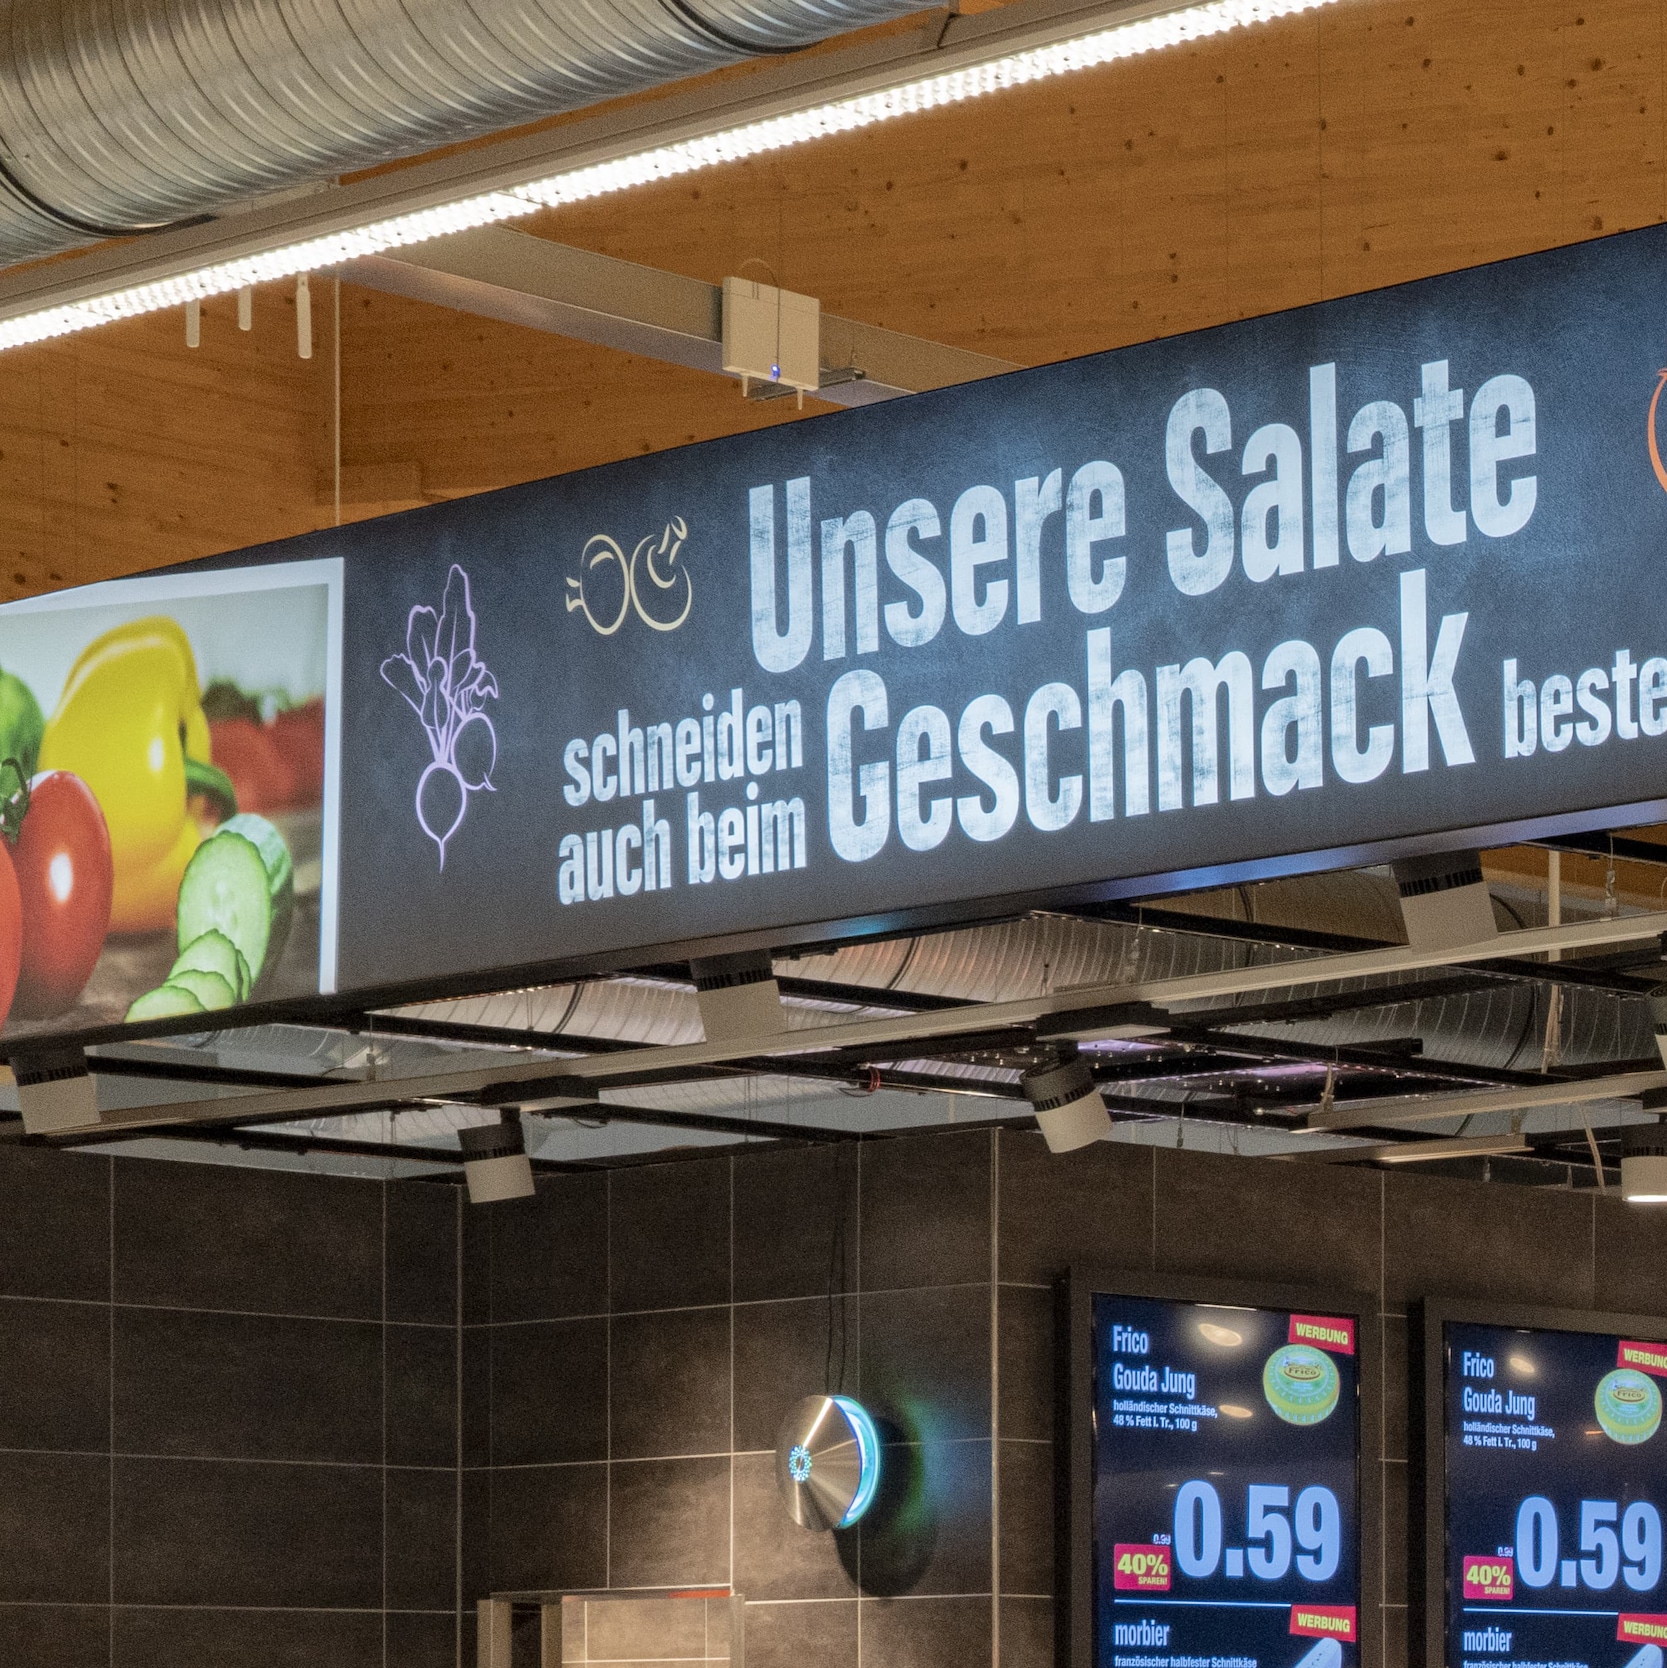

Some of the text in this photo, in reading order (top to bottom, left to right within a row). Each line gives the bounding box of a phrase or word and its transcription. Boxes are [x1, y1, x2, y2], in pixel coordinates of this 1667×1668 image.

[748, 359, 1538, 675] Unsere Salate
[557, 798, 672, 906] auch
[686, 780, 808, 885] beim
[825, 567, 1476, 863] Geschmack
[561, 687, 804, 807] schneiden
[1113, 1325, 1149, 1354] Frico
[1295, 1322, 1349, 1346] WERBUNG
[1463, 1350, 1494, 1378] Frico
[1113, 1363, 1196, 1400] Gouda Jung
[1113, 1400, 1218, 1419] holländischer Schnittkäse,
[1463, 1387, 1536, 1421] Gouda Jung
[1113, 1415, 1124, 1427] 48
[1136, 1416, 1152, 1428] Fett
[1175, 1418, 1190, 1430] 100
[1190, 1421, 1198, 1432] g
[1463, 1420, 1555, 1439] holländischer Schnittkäse,
[1174, 1479, 1341, 1582] 0.59
[1516, 1495, 1663, 1592] 0.59
[1117, 1553, 1169, 1576] 40%
[1466, 1564, 1512, 1586] 40%
[1138, 1576, 1168, 1587] SPAREN!
[1114, 1619, 1170, 1648] morbier
[1297, 1612, 1350, 1634] WERBUNG
[1463, 1626, 1513, 1653] morbier
[1114, 1655, 1169, 1668] französischer
[1170, 1656, 1211, 1668] halbfester
